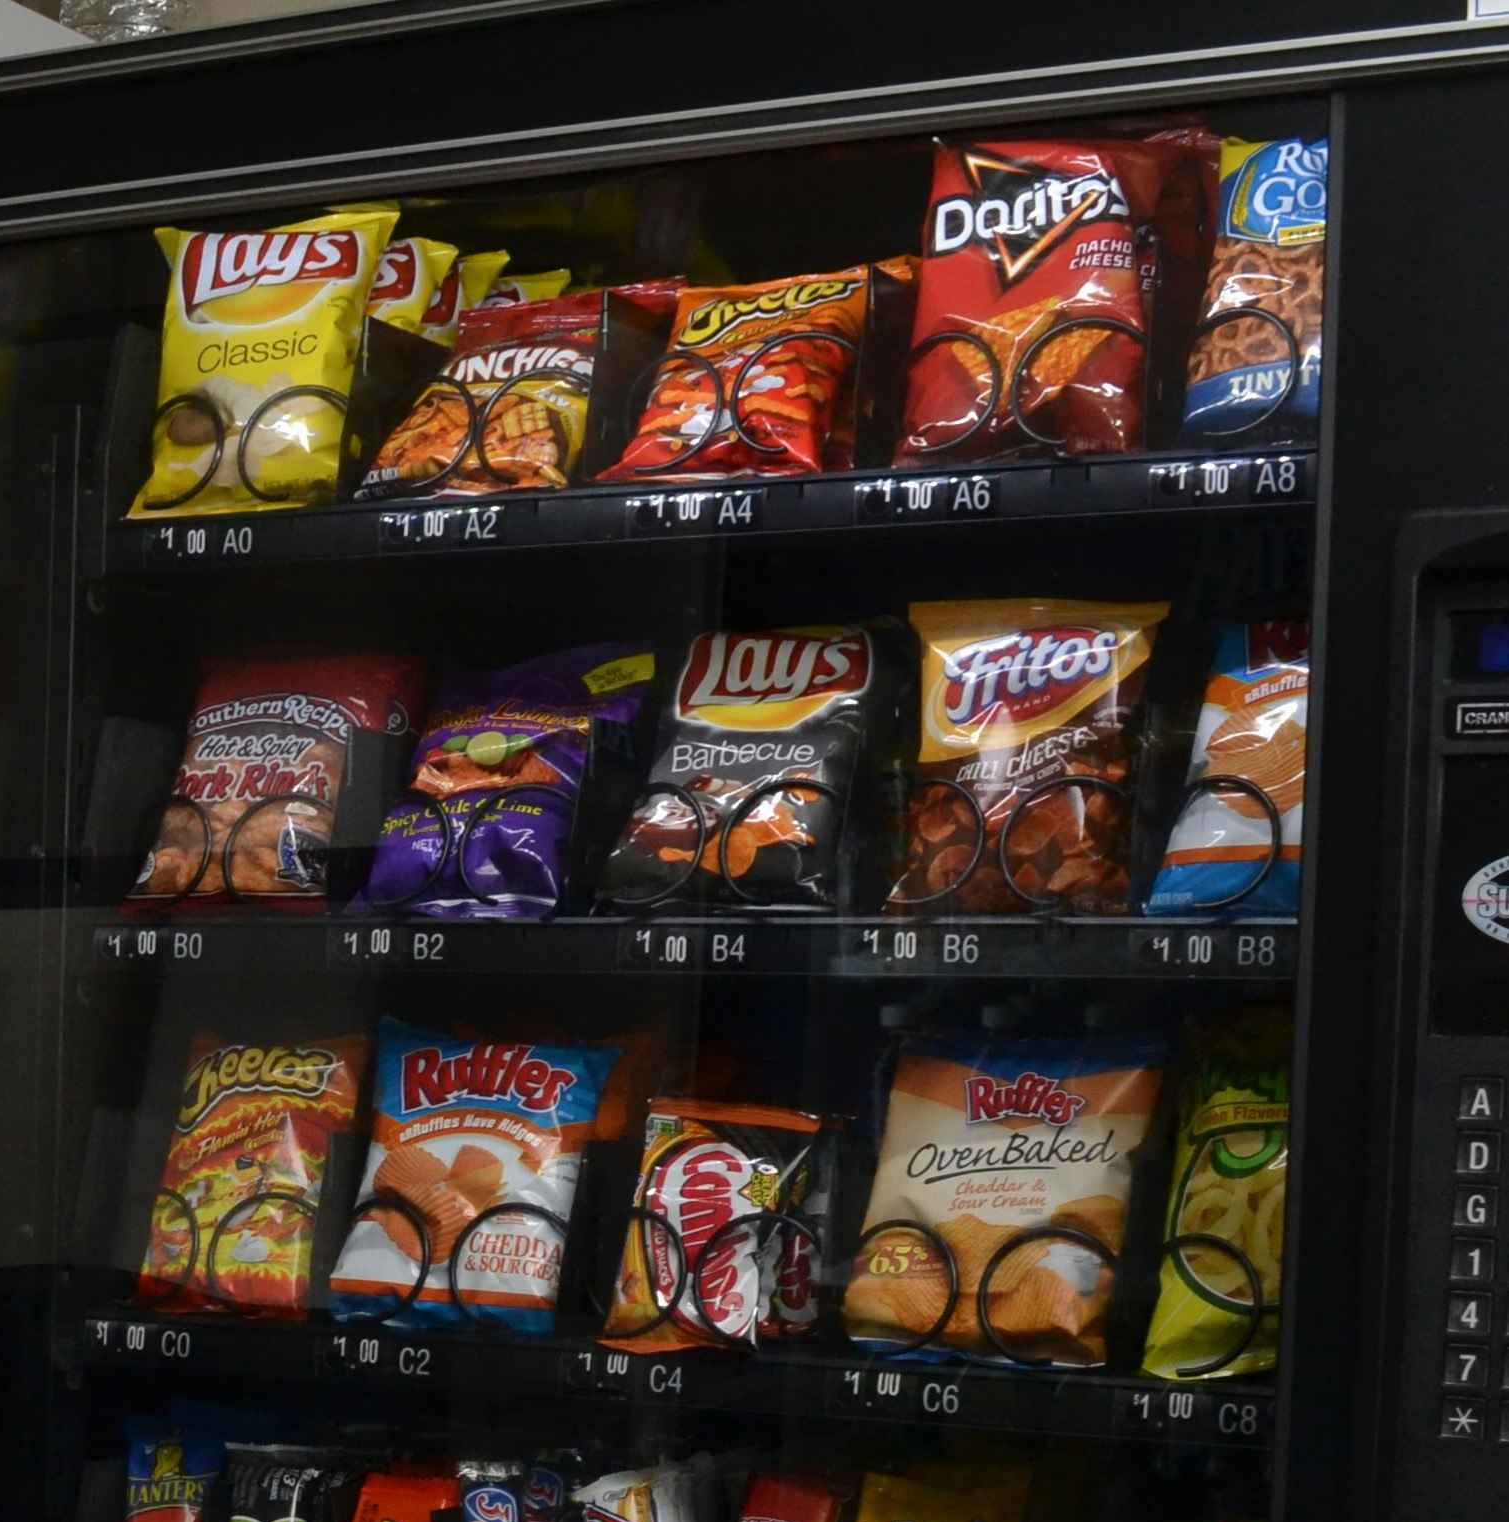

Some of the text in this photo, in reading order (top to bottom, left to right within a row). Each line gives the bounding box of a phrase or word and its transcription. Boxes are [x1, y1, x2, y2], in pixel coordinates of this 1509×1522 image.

[933, 176, 1131, 253] Doritos
[1068, 253, 1134, 270] CHEESE
[1075, 238, 1134, 256] NACHO
[197, 331, 318, 374] Classic
[1229, 368, 1292, 394] TINY
[1255, 462, 1297, 494] A8
[717, 494, 754, 526] A4
[952, 478, 992, 512] A6
[463, 509, 499, 541] A2
[222, 526, 254, 555] A0
[943, 630, 1119, 724] Fritos
[281, 693, 355, 739] Recipe
[194, 734, 316, 762] Hot & Spicy
[670, 740, 816, 774] Barbecue
[1006, 726, 1089, 778] CHEESE
[236, 761, 331, 802] Rinds
[495, 797, 544, 817] Lime
[173, 932, 203, 959] B0
[413, 932, 444, 960] B2
[711, 934, 746, 964] B4
[942, 933, 980, 964] B6
[1236, 935, 1276, 965] B8
[178, 1046, 331, 1124] Cheetos
[402, 1040, 577, 1114] Ruffles
[963, 1071, 1087, 1126] Ruffles
[1469, 1087, 1491, 1116] A
[463, 1114, 543, 1148] Have Ridges
[906, 1125, 1119, 1178] Oven Baked
[1468, 1141, 1489, 1170] D
[955, 1178, 1025, 1196] Cheddar
[990, 1195, 1048, 1210] Cream
[1465, 1194, 1487, 1224] G
[679, 1150, 752, 1323] Combos
[464, 1254, 521, 1275] & SOUR
[869, 1243, 929, 1276] 65%
[1467, 1248, 1481, 1276] 1
[1460, 1301, 1479, 1330] 4
[161, 1331, 191, 1358] C0
[398, 1346, 431, 1376] C2
[1458, 1353, 1478, 1381] 7
[649, 1364, 684, 1394] C4
[922, 1381, 960, 1415] C6
[1218, 1402, 1258, 1435] C8
